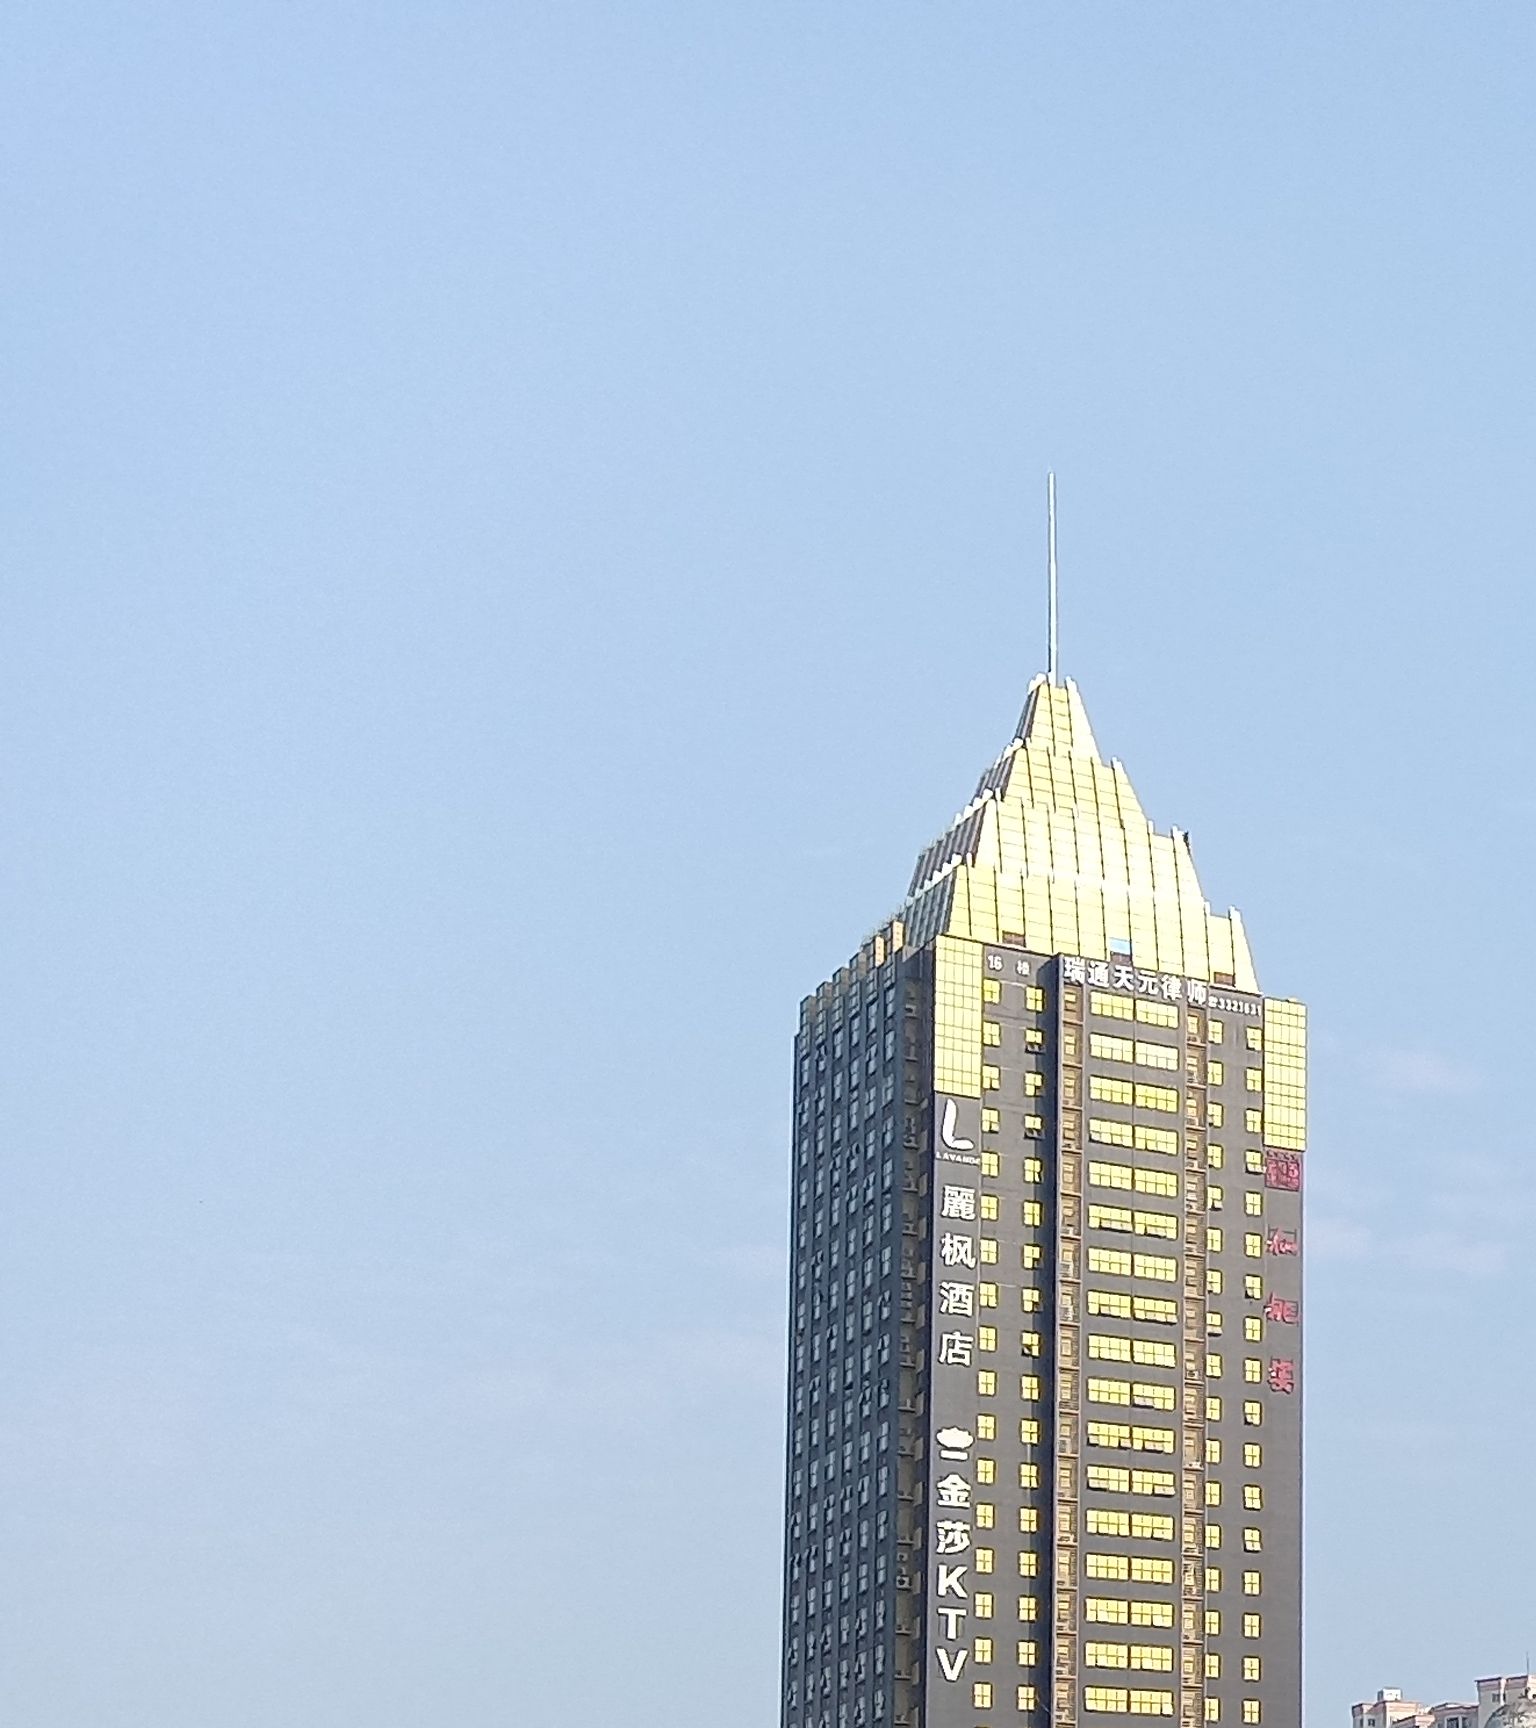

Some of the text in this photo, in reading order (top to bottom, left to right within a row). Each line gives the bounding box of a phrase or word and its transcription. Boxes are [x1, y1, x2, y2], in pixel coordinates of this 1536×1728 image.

[988, 955, 1003, 971] 16
[1062, 955, 1207, 1008] 瑞通天元律师
[938, 1185, 977, 1366] 麗枫酒店
[935, 1473, 972, 1683] 金莎KTV
